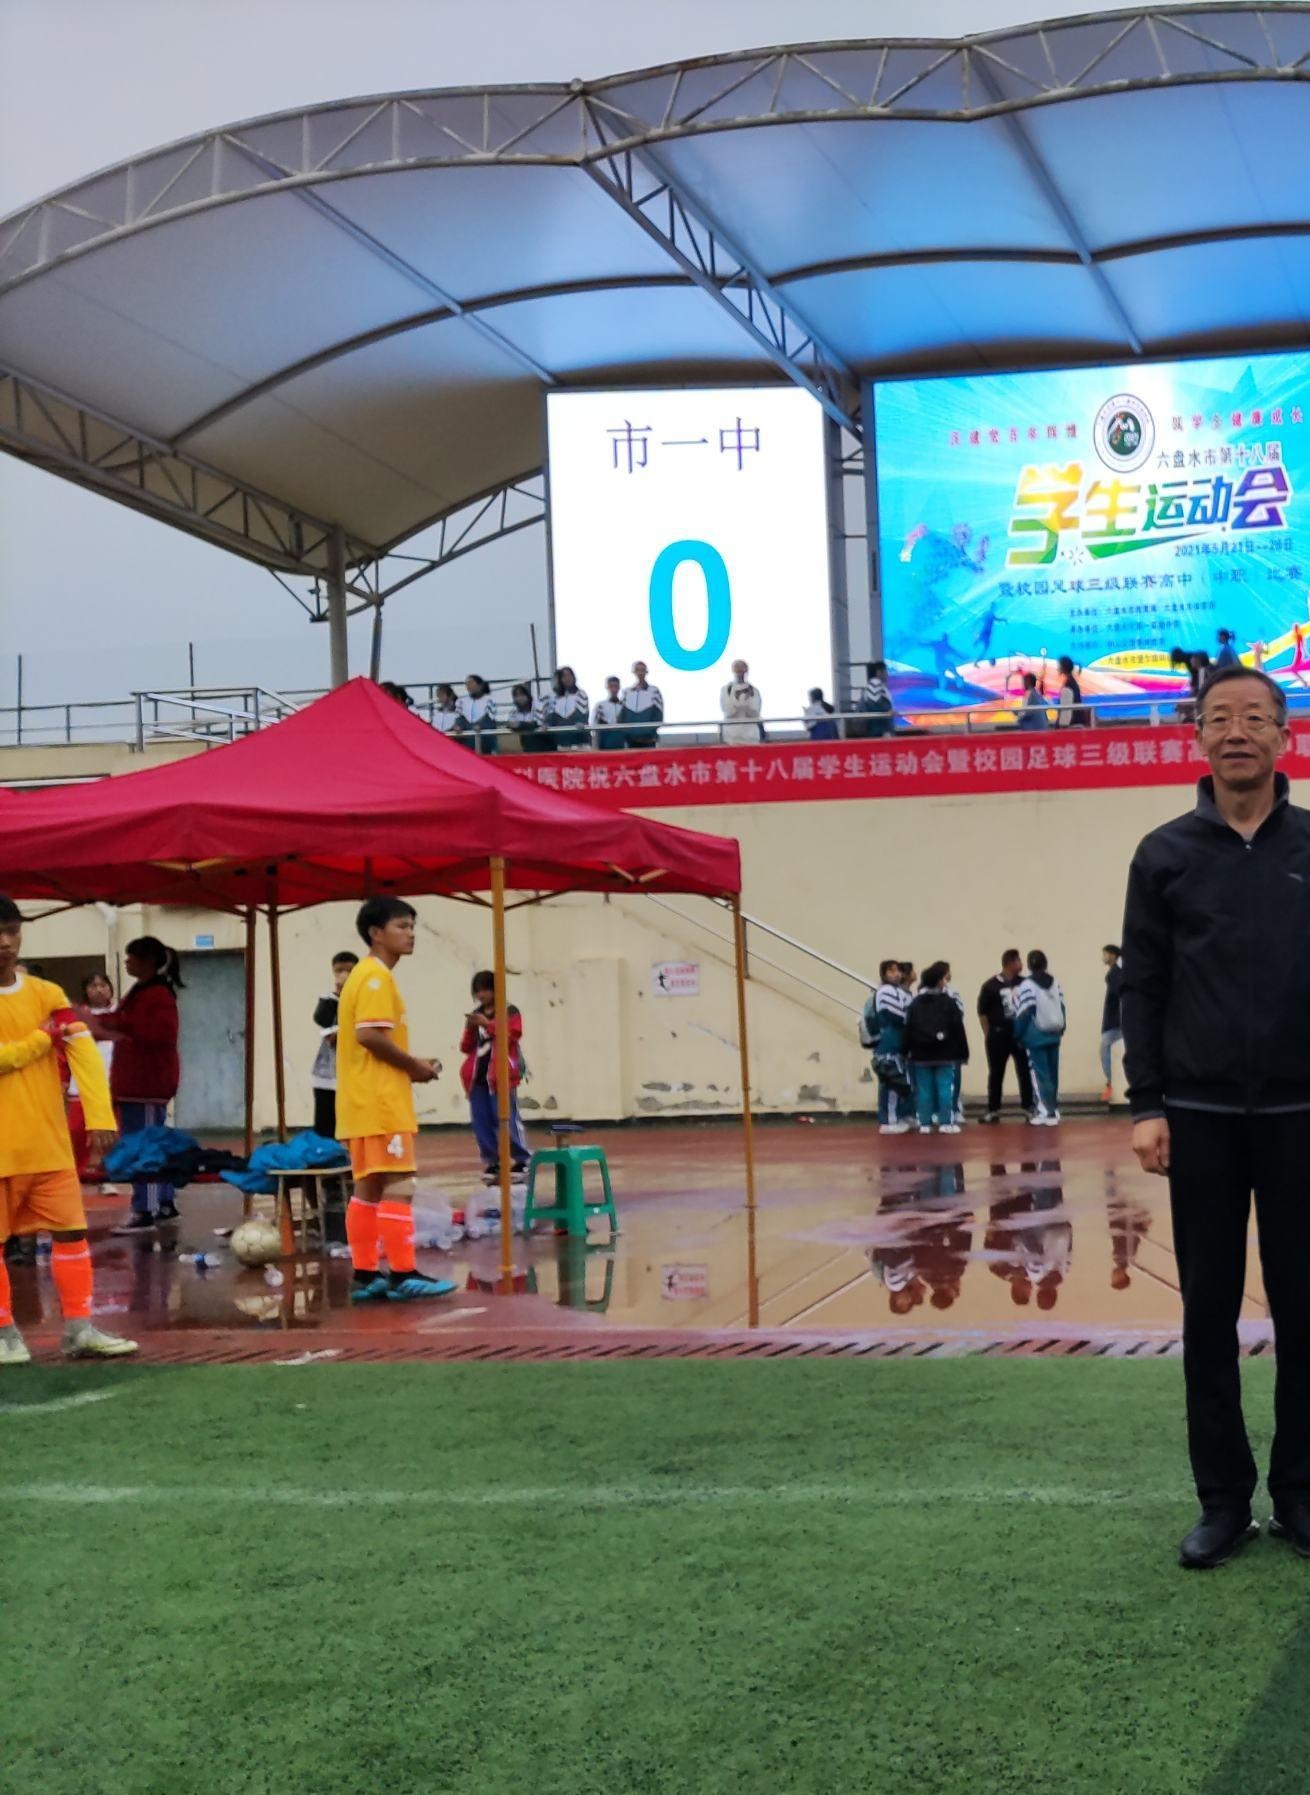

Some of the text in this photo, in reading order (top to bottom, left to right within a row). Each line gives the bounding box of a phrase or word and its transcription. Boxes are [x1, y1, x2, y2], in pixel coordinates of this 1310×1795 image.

[606, 416, 761, 474] 市一中
[1157, 442, 1281, 470] 六盘水市第十八届
[1006, 461, 1289, 566] 学生运动会
[649, 539, 732, 672] 0
[387, 1134, 403, 1159] 4
